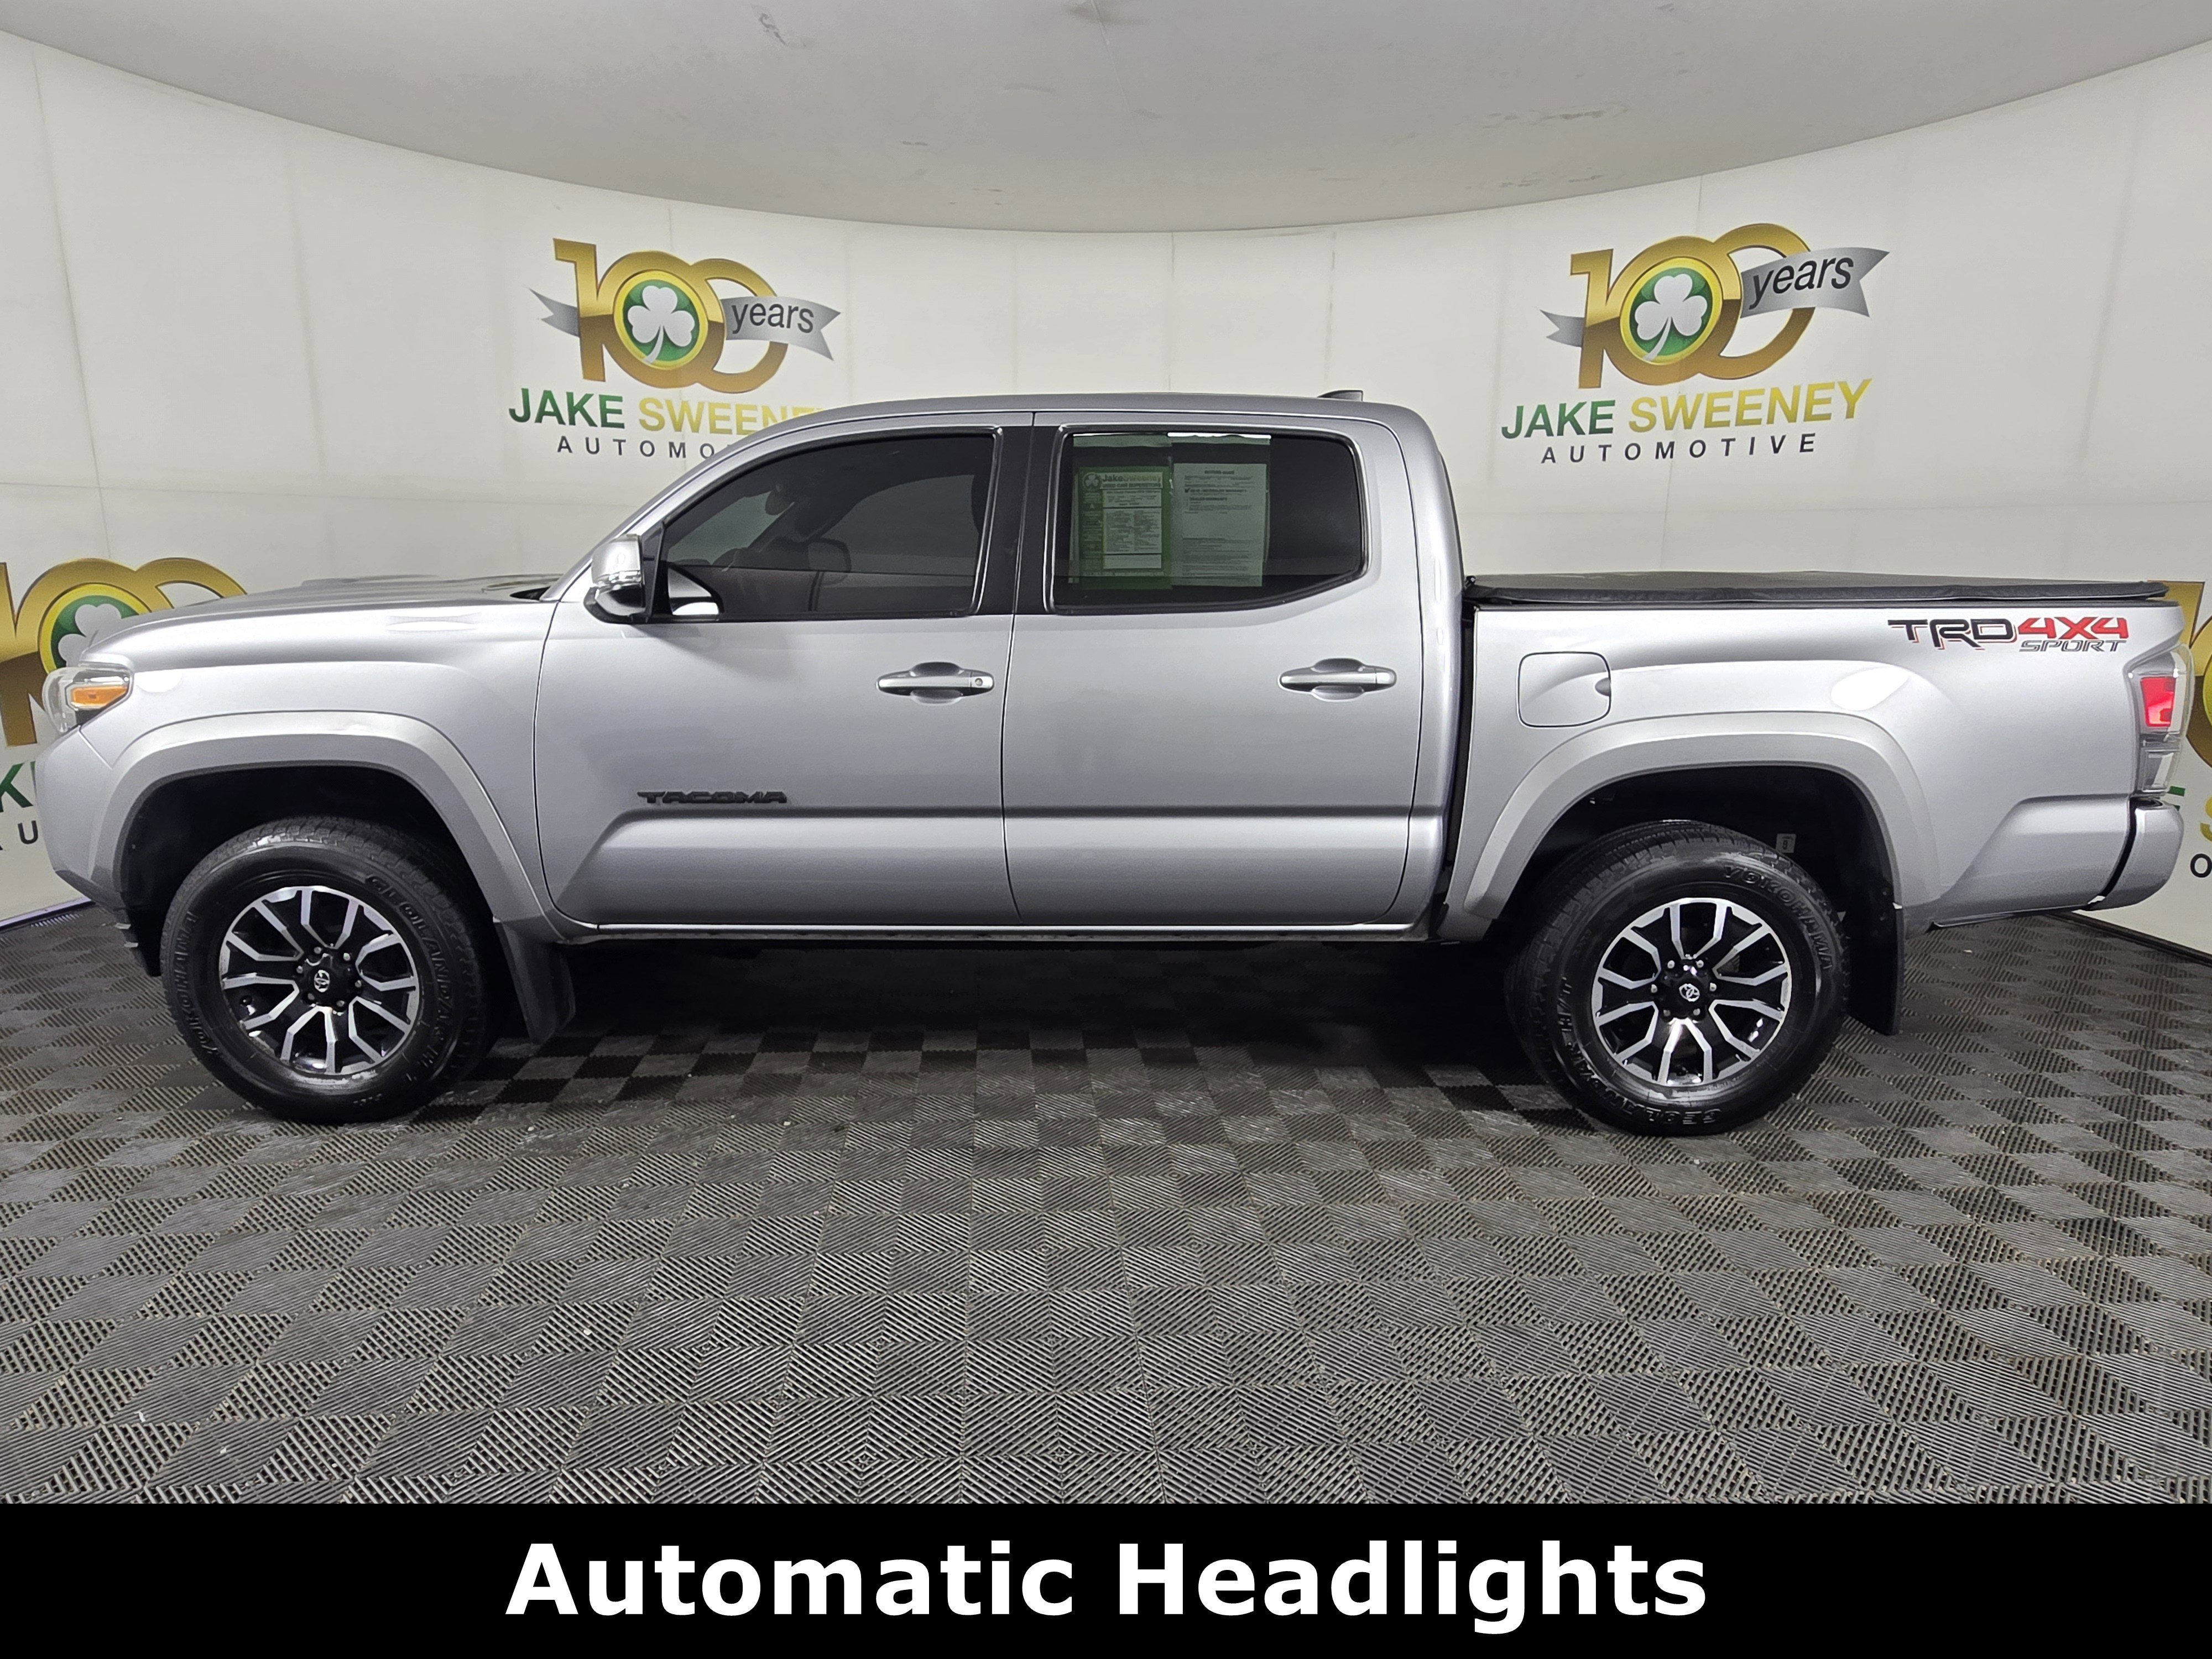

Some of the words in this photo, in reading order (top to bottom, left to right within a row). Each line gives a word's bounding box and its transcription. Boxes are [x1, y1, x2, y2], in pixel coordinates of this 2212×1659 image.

[1571, 223, 1816, 389] 100
[1749, 256, 1854, 310] years
[553, 238, 788, 394] 100
[731, 302, 815, 335] years
[509, 388, 625, 429] JAKE
[639, 397, 825, 436] SWEEN
[1501, 399, 1616, 439] JAKE
[1629, 378, 1873, 432] SWEENEY
[557, 436, 732, 458] AUTOMO
[1541, 432, 1817, 464] AUTOMOTIVE
[1888, 619, 2017, 650] TRD
[2019, 640, 2127, 652] SPORT
[637, 791, 787, 804] TACOMA
[1724, 864, 1835, 970] YOKOHAMA
[174, 910, 219, 1055] YOKOHAMA
